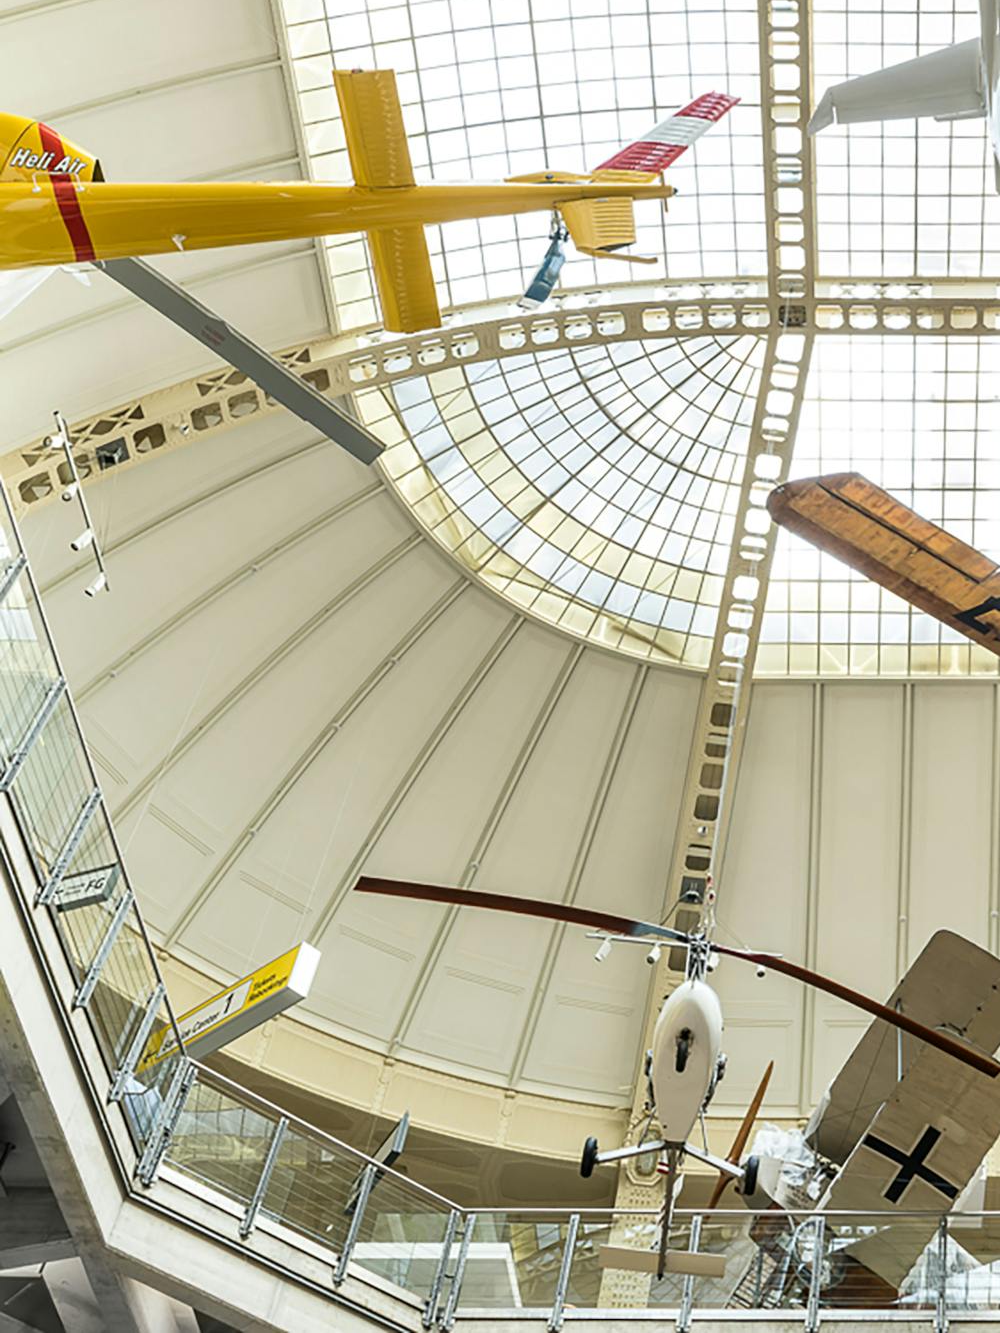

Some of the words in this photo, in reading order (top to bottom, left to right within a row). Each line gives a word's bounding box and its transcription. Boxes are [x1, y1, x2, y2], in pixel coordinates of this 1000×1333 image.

[10, 147, 56, 170] Heli
[53, 155, 87, 174] Air
[223, 993, 234, 1014] 1
